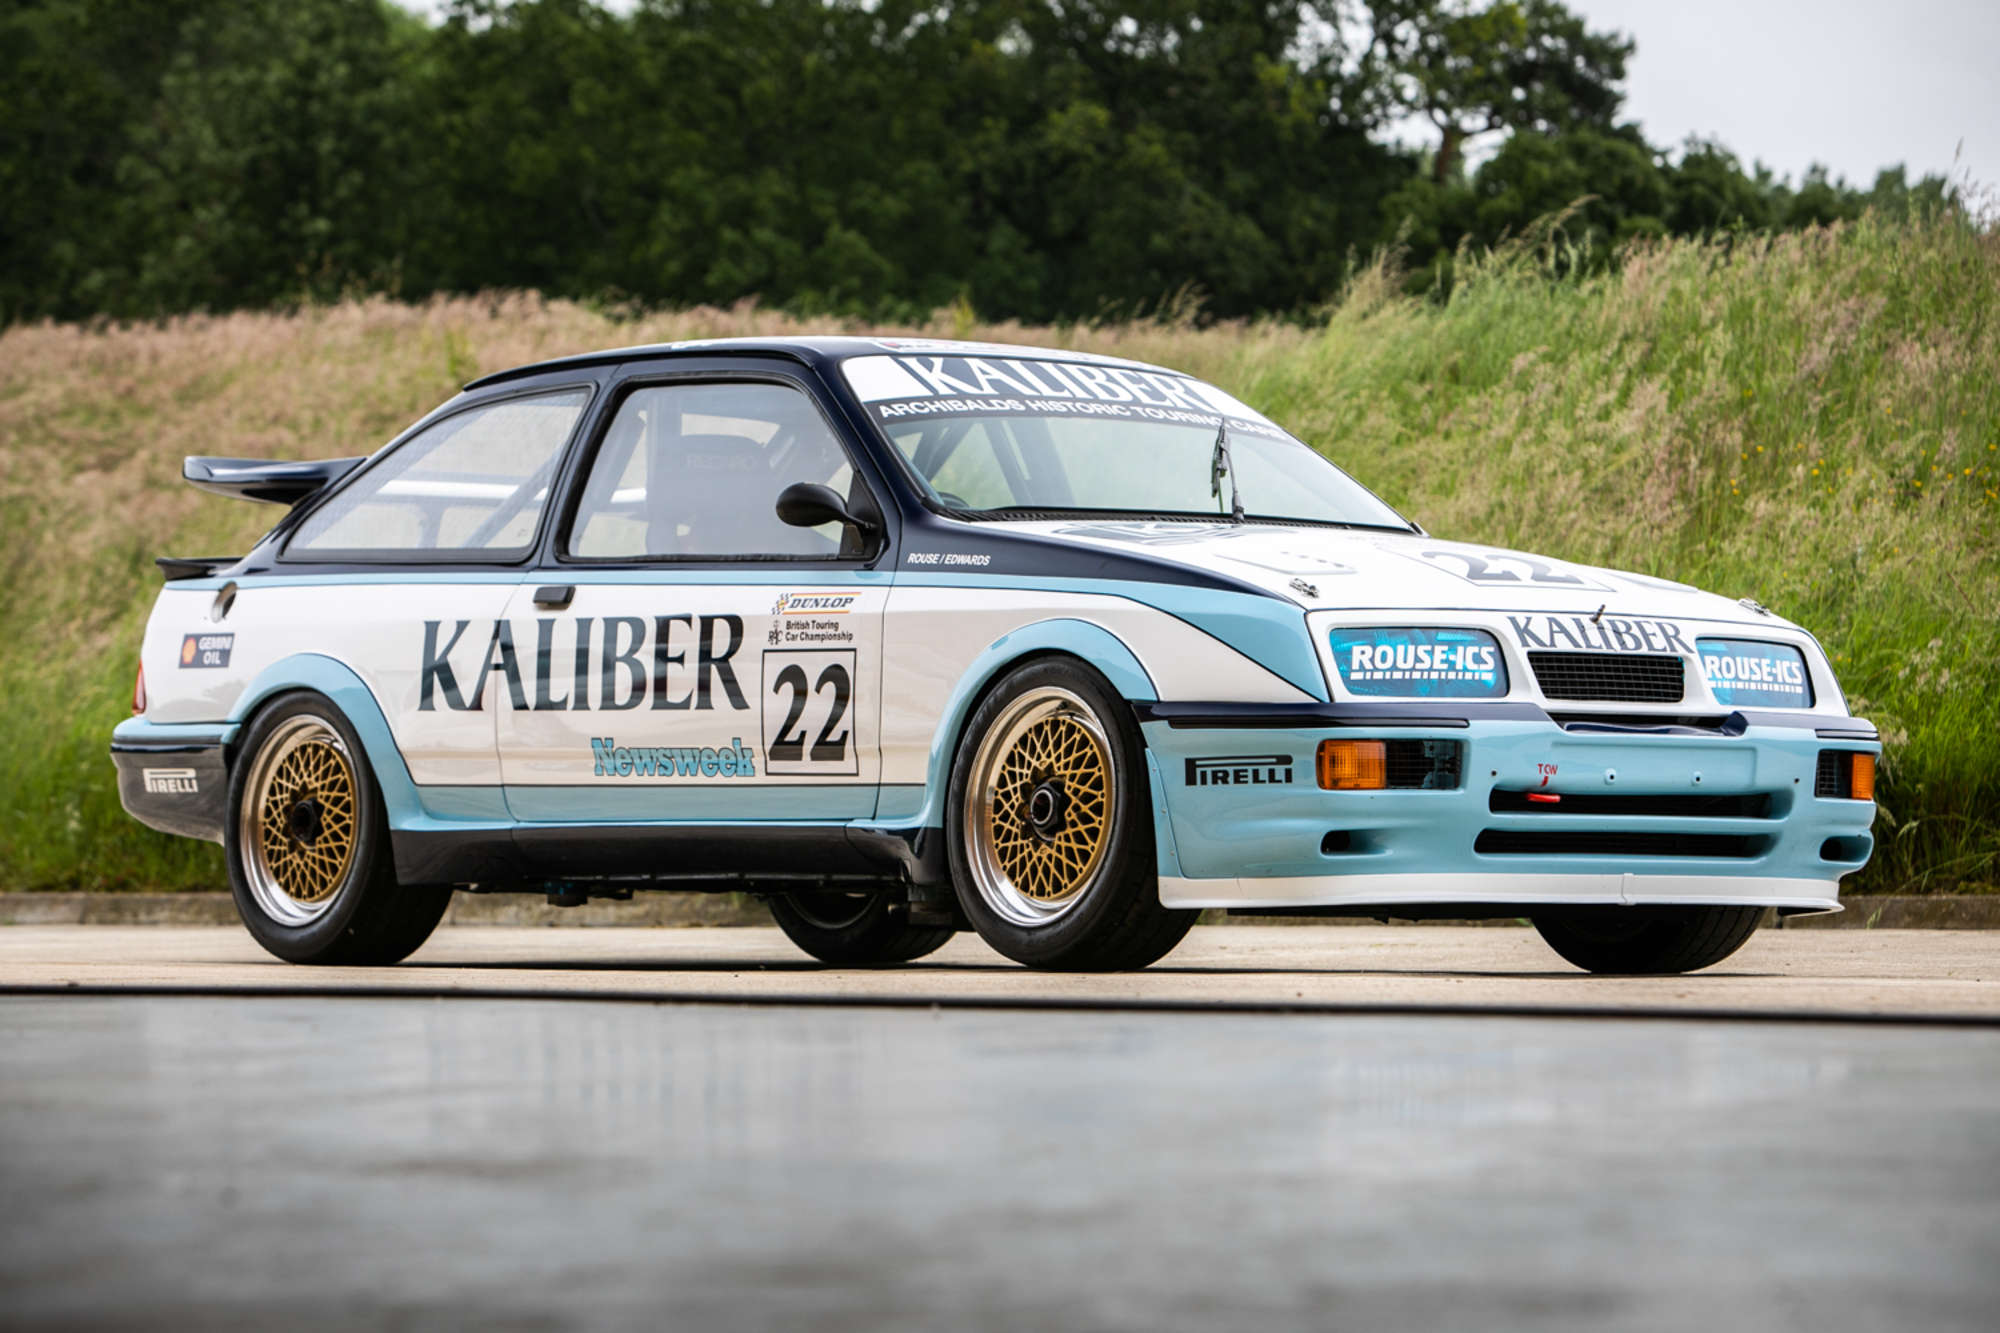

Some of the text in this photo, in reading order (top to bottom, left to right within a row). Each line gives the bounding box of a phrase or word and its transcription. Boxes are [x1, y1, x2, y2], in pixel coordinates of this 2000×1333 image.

[894, 355, 1221, 414] KALIBER
[879, 399, 1026, 418] ARCHIBALDS
[1025, 399, 1131, 416] HISTORIC
[1130, 406, 1229, 428] TOURING
[1421, 551, 1584, 584] 22
[788, 597, 854, 609] DUNLOP
[785, 619, 840, 632] British Touring
[785, 630, 854, 643] Car Championship
[1507, 615, 1695, 654] KALIBER
[203, 651, 221, 665] OIL
[416, 613, 751, 712] KALIBER
[1350, 644, 1496, 671] ROUSE-ICS
[1703, 654, 1804, 685] ROUSE-ICS
[767, 663, 851, 762] 22
[591, 737, 756, 777] Newsweek
[1184, 754, 1294, 787] PIRELLI
[1536, 762, 1559, 776] TOW
[142, 767, 199, 793] PIRELLI
